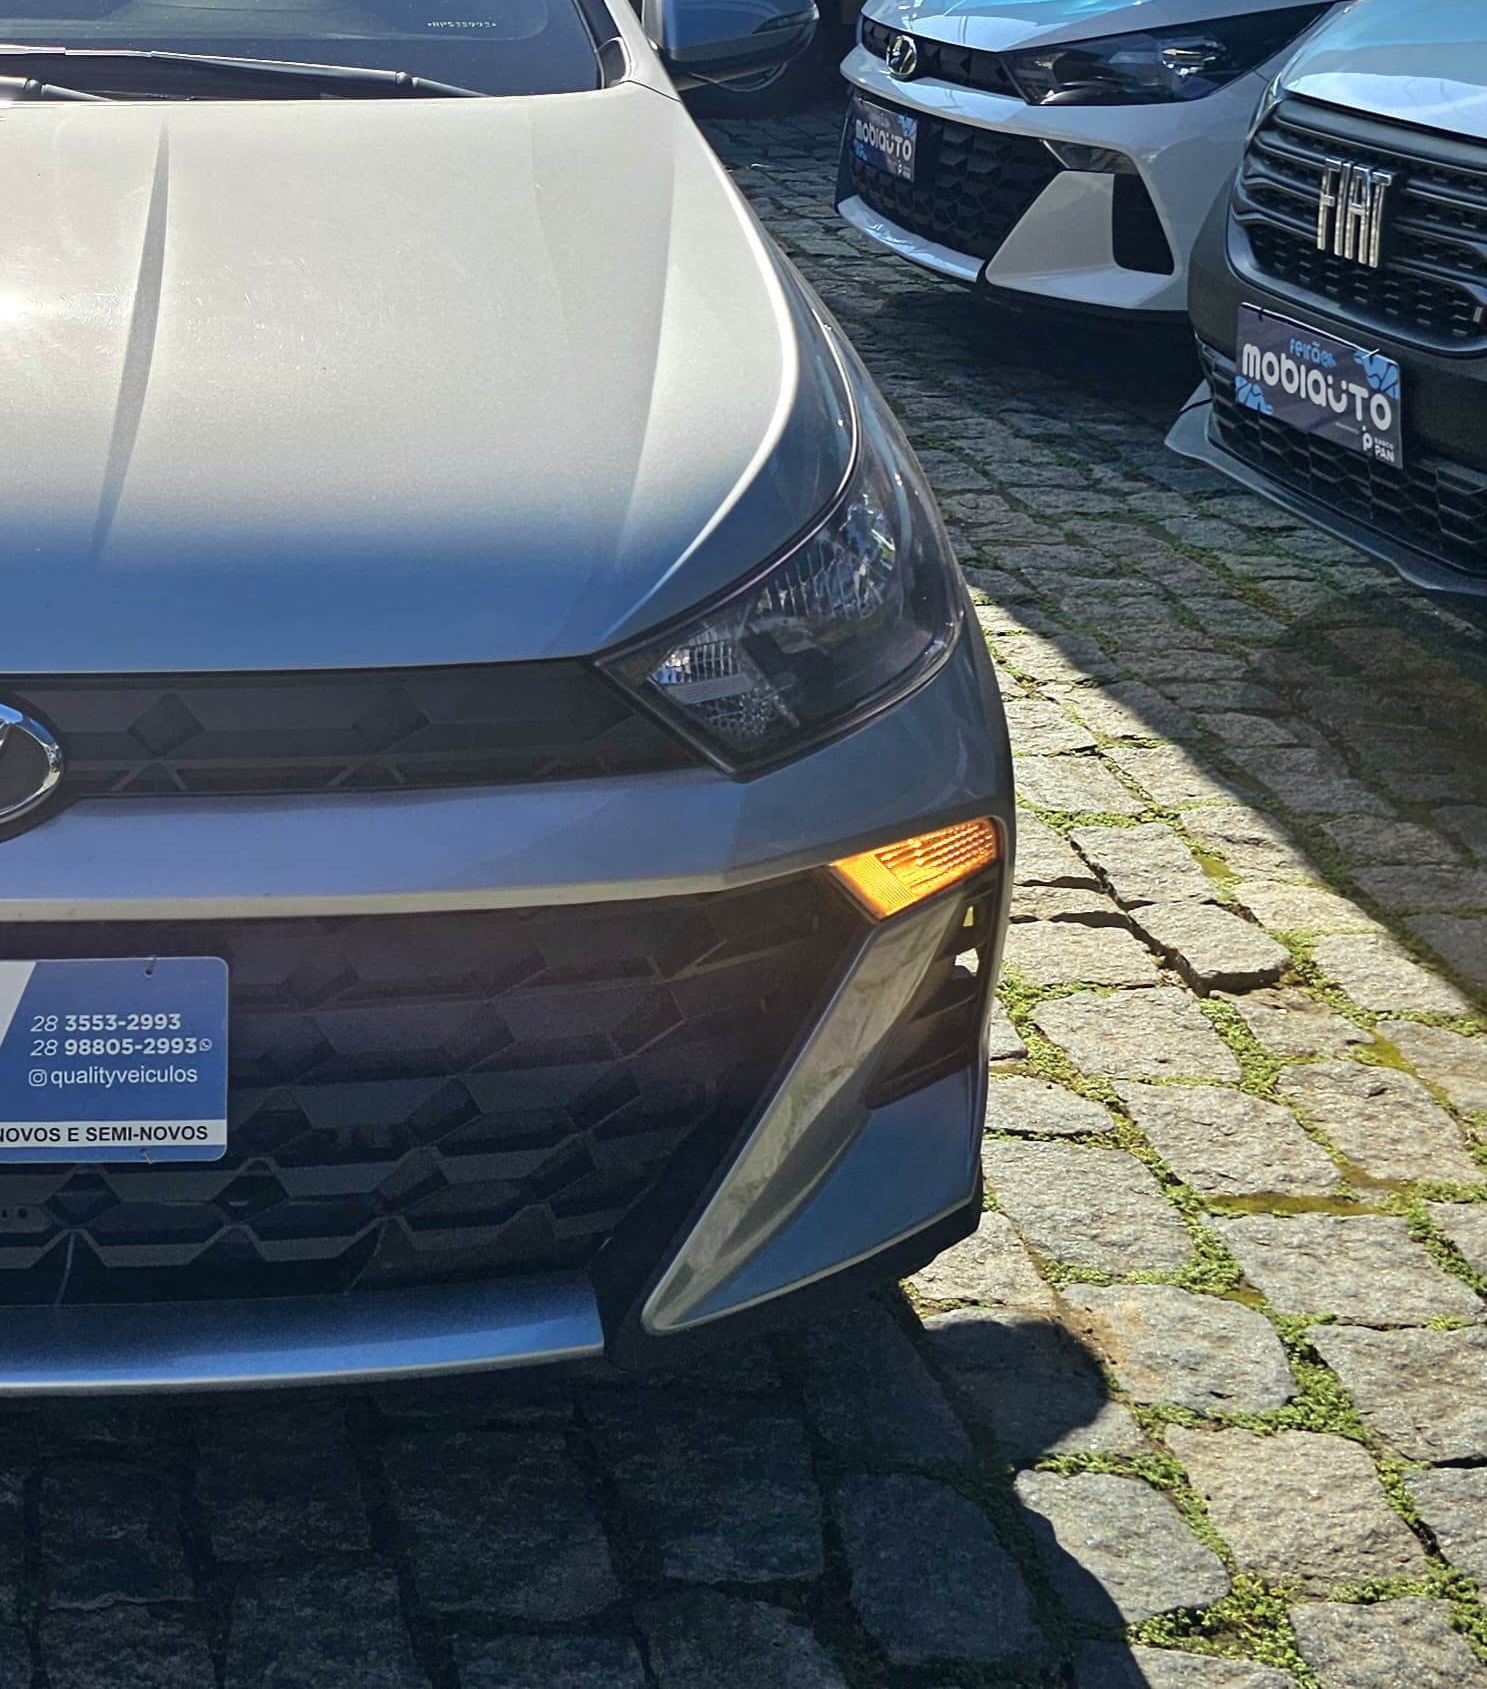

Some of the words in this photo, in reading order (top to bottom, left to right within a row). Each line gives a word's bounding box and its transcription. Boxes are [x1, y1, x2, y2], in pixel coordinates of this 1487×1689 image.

[1316, 158, 1393, 268] FIAT
[1375, 444, 1395, 462] PAN
[30, 1015, 59, 1032] 28
[64, 1013, 182, 1032] 3553-2993
[30, 1039, 59, 1056] 28
[64, 1037, 198, 1056] 98805-2993
[50, 1065, 199, 1089] qualityveiculos
[67, 1127, 80, 1142] E
[85, 1125, 209, 1142] SEMI-NOVOS
